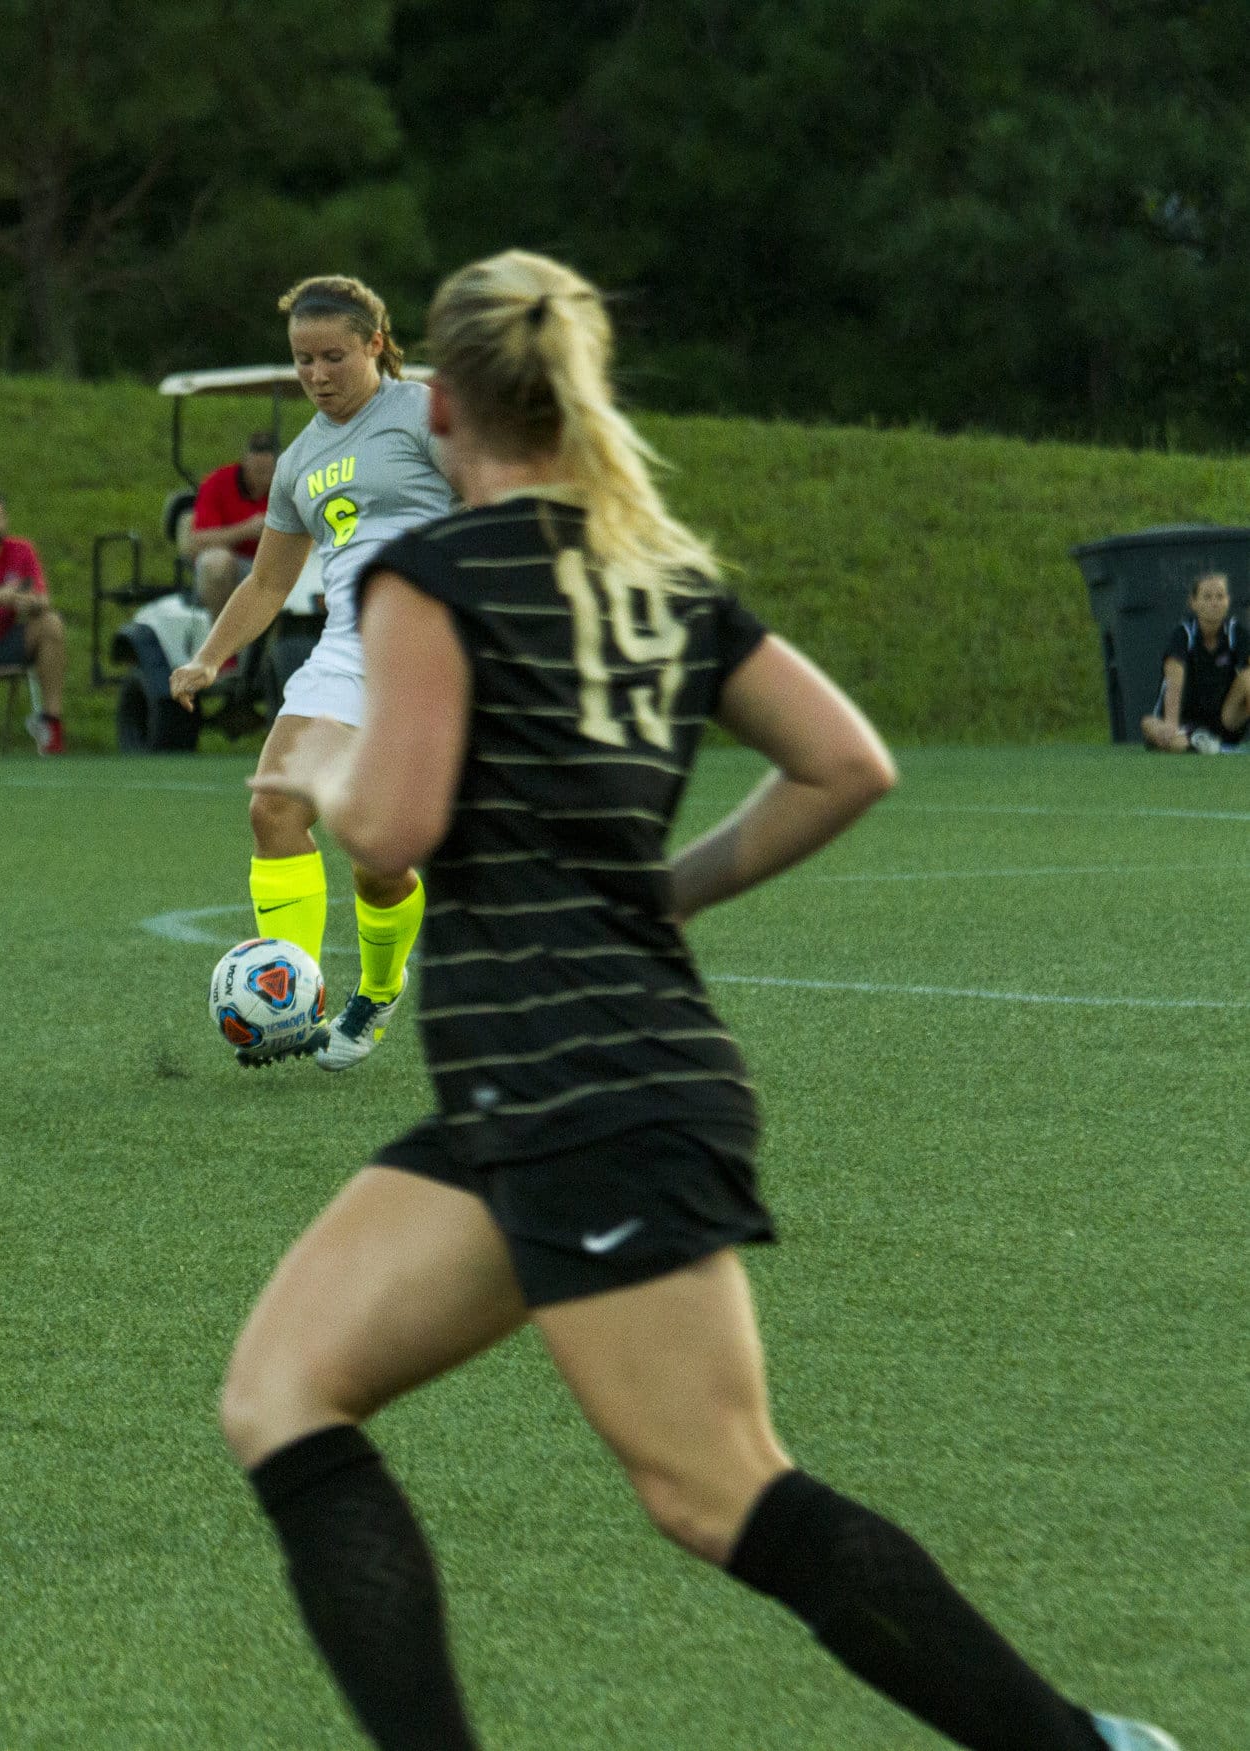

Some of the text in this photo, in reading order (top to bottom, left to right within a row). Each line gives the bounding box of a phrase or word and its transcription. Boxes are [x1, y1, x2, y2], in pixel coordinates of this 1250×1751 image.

[307, 456, 356, 500] NGU
[323, 496, 359, 548] 6
[554, 548, 688, 751] 19
[224, 964, 237, 997] NCAA
